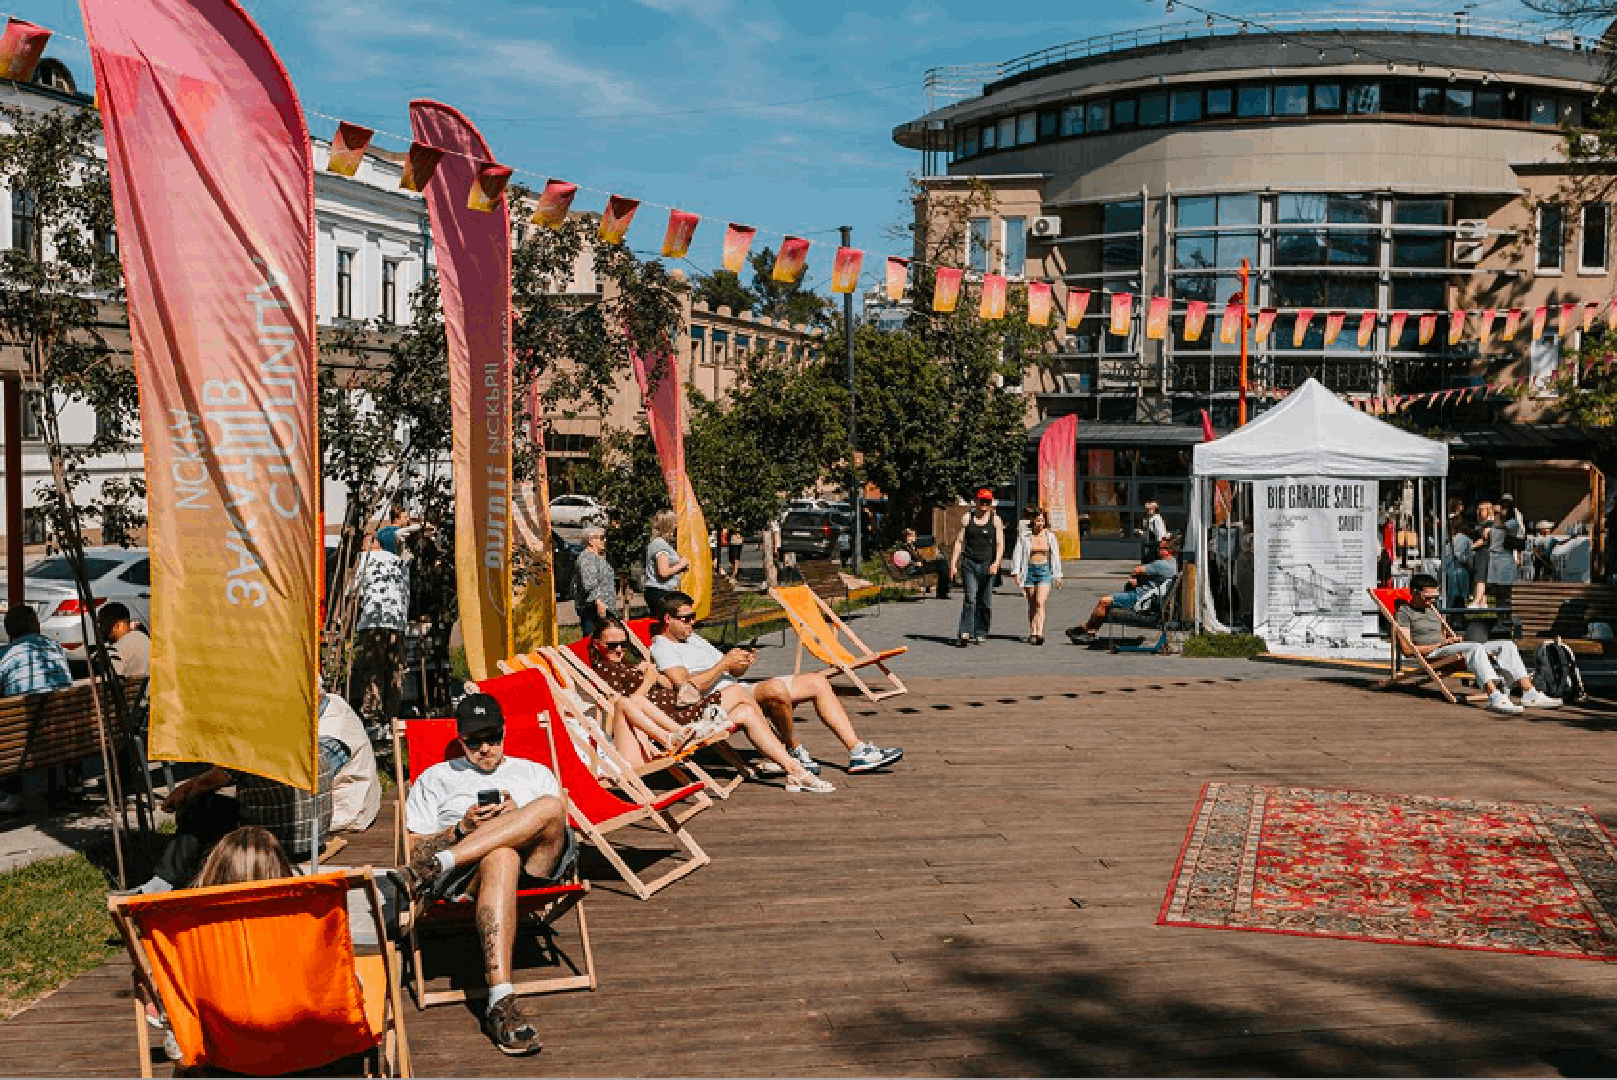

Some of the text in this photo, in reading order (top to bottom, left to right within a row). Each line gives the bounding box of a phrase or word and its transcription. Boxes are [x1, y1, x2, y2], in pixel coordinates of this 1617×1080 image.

[1267, 485, 1365, 509] BIG GARAGE SALE!
